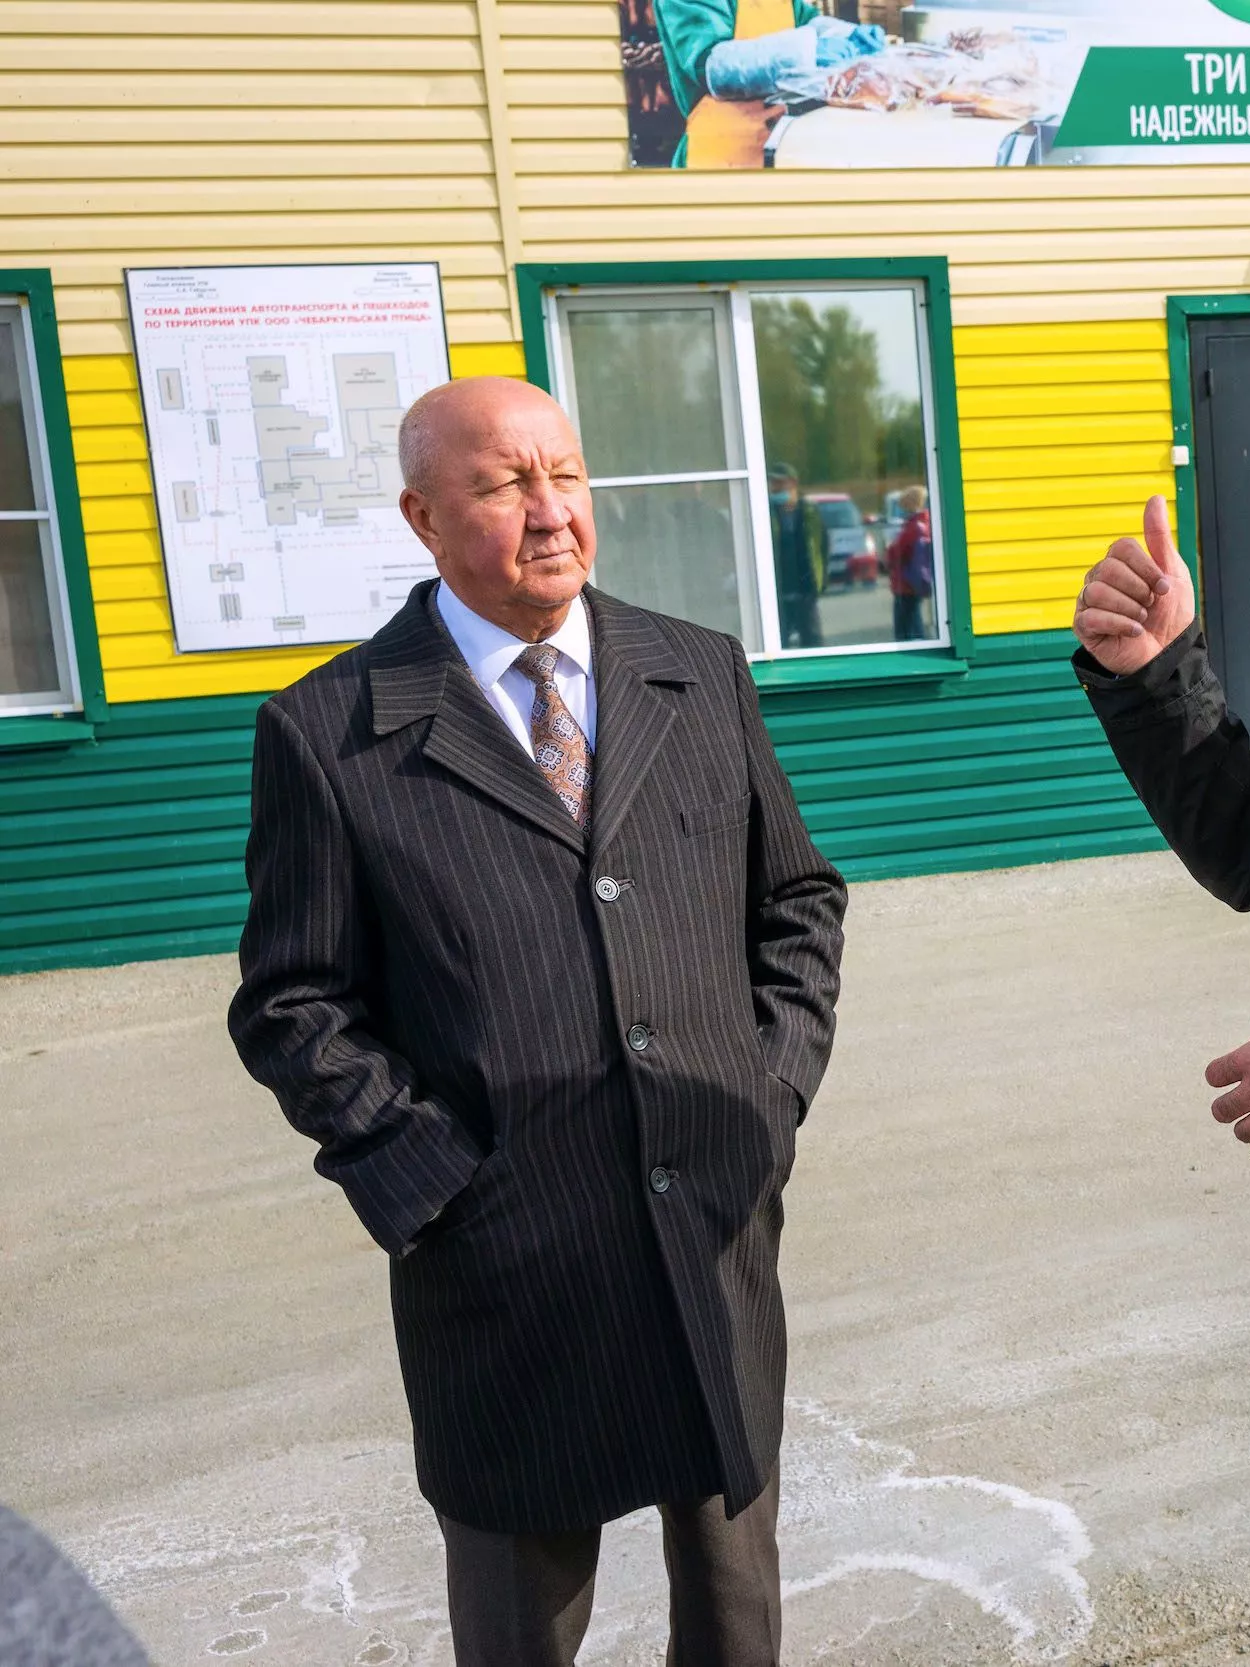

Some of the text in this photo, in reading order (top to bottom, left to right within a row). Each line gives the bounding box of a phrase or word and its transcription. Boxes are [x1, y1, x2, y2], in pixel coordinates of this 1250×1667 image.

[1184, 52, 1247, 95] ТРИ
[144, 301, 429, 316] СХЕМА ДВИЖЕНИЯ АВТОТРАНСПОРТА И ПЕШЕХОДОВ
[144, 319, 161, 329] ПО
[165, 318, 235, 329] ТЕРРИТОРИИ
[239, 317, 260, 327] УПК
[264, 316, 290, 326] ООО
